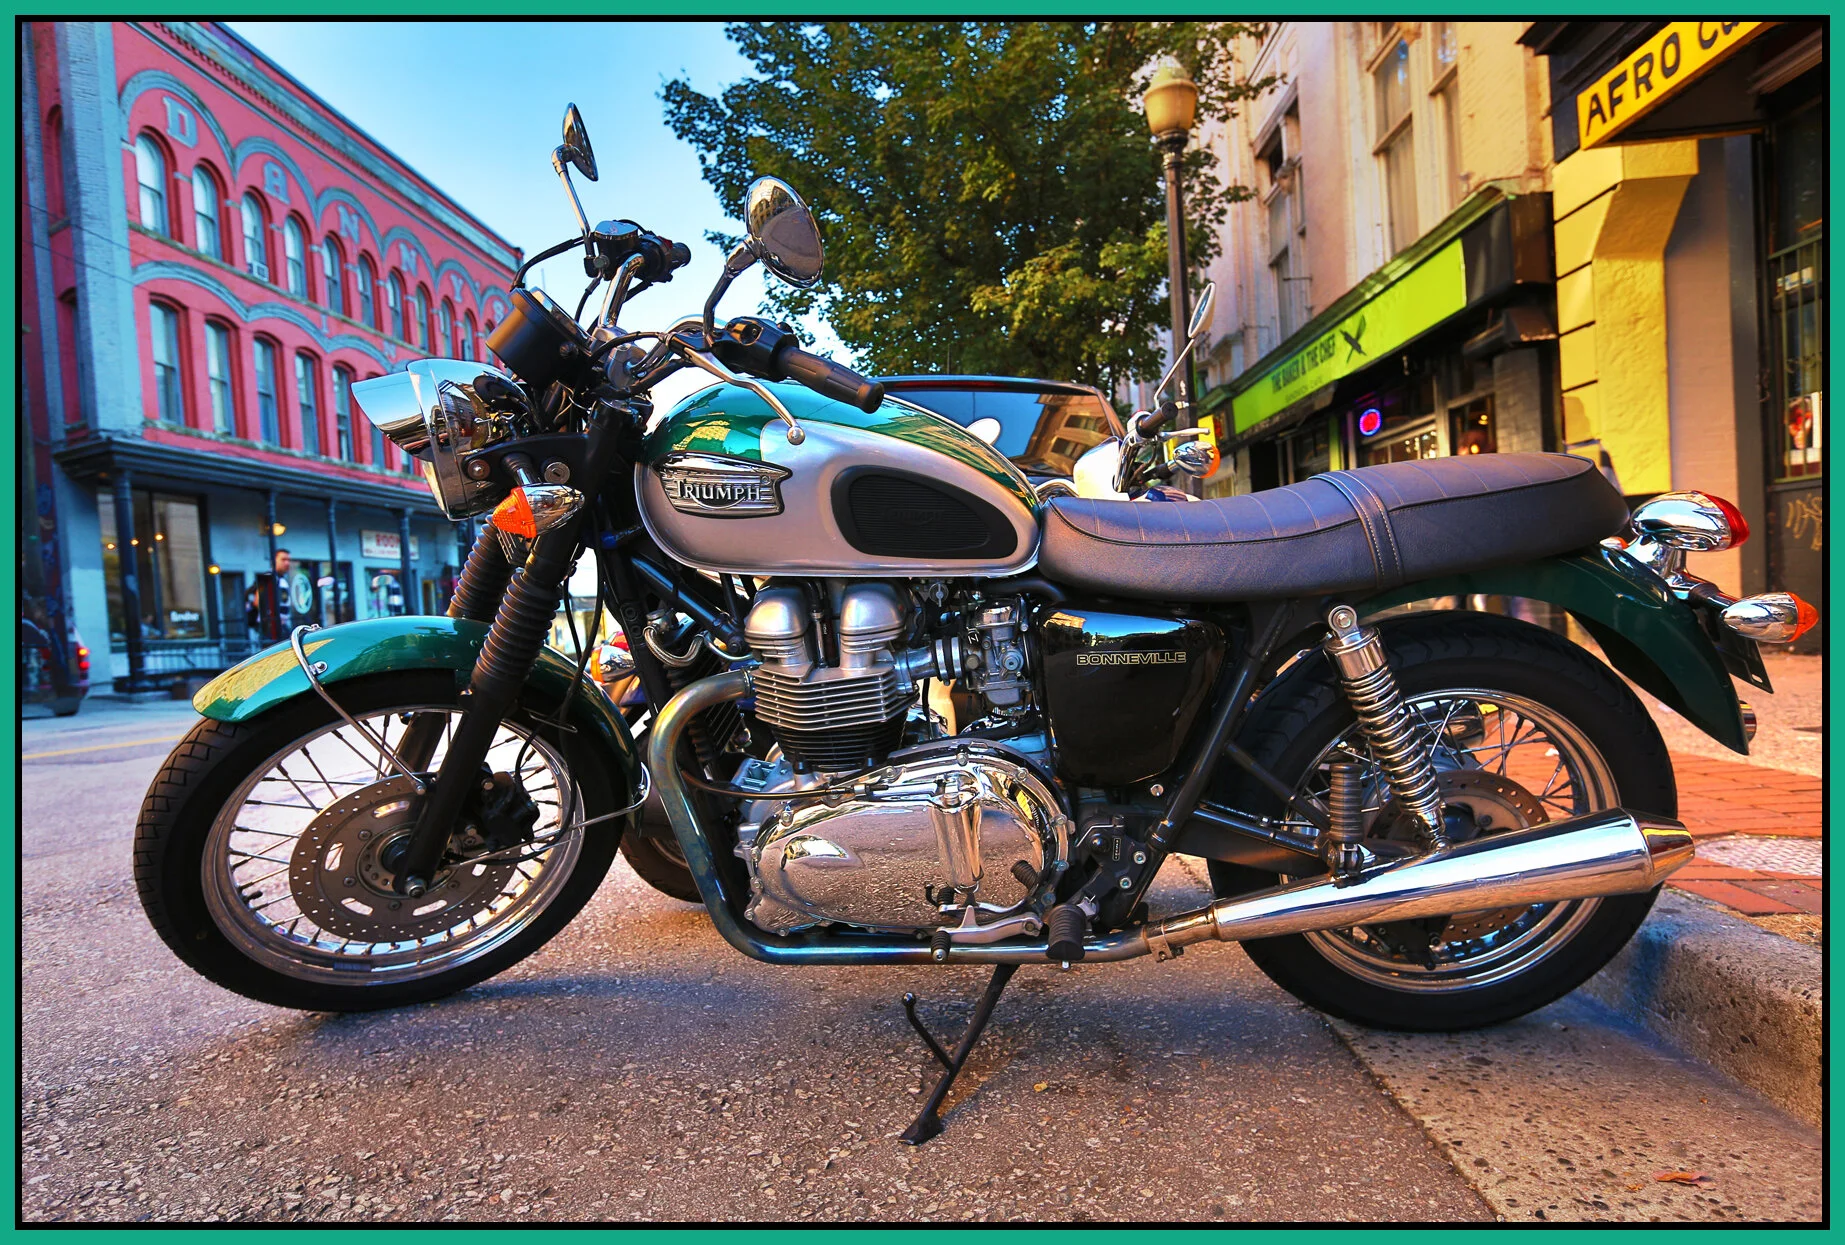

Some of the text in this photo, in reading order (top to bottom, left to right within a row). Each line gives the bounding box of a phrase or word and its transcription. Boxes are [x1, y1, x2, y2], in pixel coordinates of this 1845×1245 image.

[1586, 32, 1680, 136] AFRO
[1271, 374, 1282, 394] THE
[1282, 359, 1299, 387] BAKER
[1306, 346, 1319, 372] THE
[1320, 334, 1335, 362] CHEF
[674, 479, 761, 502] TRIUMPH
[1076, 652, 1187, 666] BONNEVILLE
